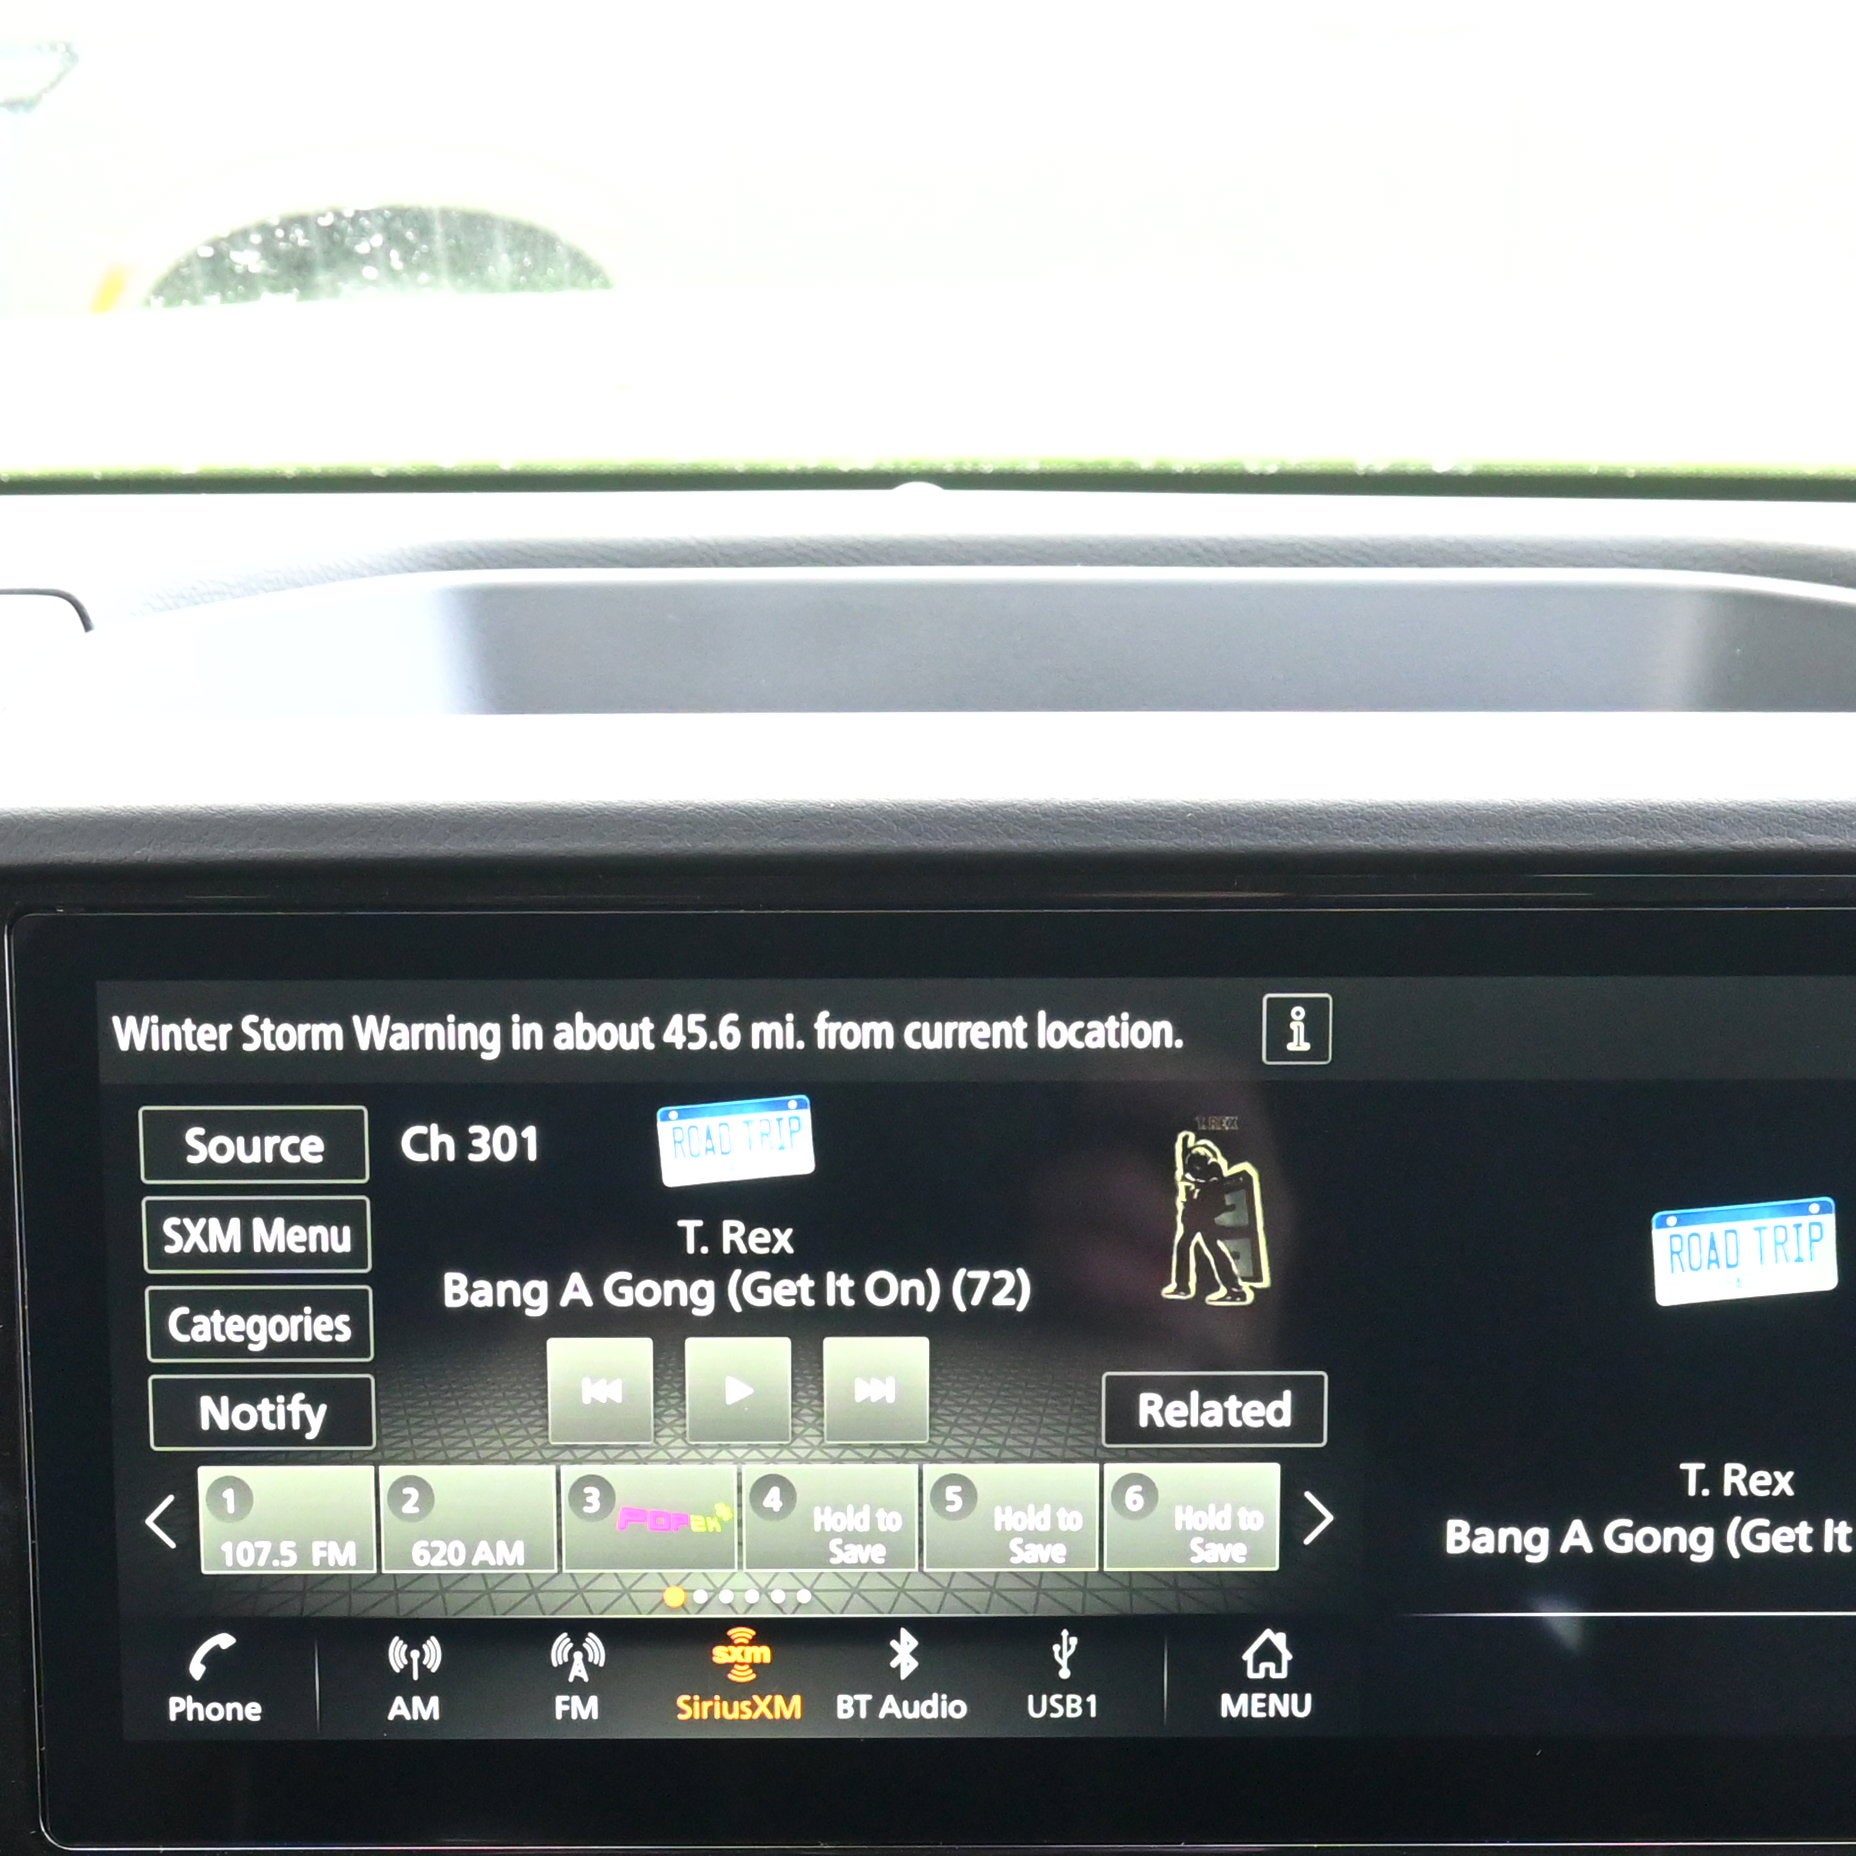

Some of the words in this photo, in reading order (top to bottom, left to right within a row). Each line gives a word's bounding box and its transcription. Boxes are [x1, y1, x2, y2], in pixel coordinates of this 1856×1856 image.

[111, 1013, 232, 1052] Winter
[242, 1013, 344, 1052] Storm
[353, 1013, 502, 1060] Warning
[512, 1013, 544, 1051] in
[553, 1012, 656, 1051] about
[662, 1013, 741, 1051] 45.6
[751, 1013, 805, 1050] mi.
[814, 1011, 894, 1050] from
[903, 1016, 1028, 1050] current
[1037, 1010, 1184, 1050] location.
[184, 1126, 325, 1165] Source
[400, 1124, 456, 1163] Ch
[467, 1125, 539, 1163] 301
[670, 1120, 732, 1161] ROAD
[742, 1113, 805, 1154] TRIP
[162, 1217, 241, 1255] SXM
[252, 1217, 352, 1255] Menu
[677, 1219, 709, 1255] T.
[723, 1219, 794, 1255] Rex
[1669, 1229, 1740, 1274] ROAD
[1753, 1221, 1825, 1265] TRIP
[443, 1272, 548, 1317] Bang
[560, 1273, 594, 1308] A
[603, 1271, 716, 1317] Gong
[726, 1270, 815, 1314] (Get
[824, 1271, 857, 1306] It
[865, 1269, 942, 1314] On)
[952, 1267, 1033, 1313] (72)
[168, 1306, 352, 1352] Categories
[198, 1394, 328, 1440] Notify
[1137, 1391, 1293, 1430] Related
[1678, 1462, 1711, 1496] T.
[1723, 1462, 1795, 1496] Rex
[221, 1488, 237, 1513] 1
[402, 1488, 420, 1513] 2
[581, 1486, 602, 1513] 3
[762, 1486, 784, 1513] 4
[943, 1486, 963, 1512] 5
[1124, 1485, 1144, 1512] 6
[813, 1504, 871, 1532] Hold
[875, 1507, 903, 1532] to
[994, 1504, 1049, 1532] Hold
[1056, 1506, 1084, 1532] to
[1174, 1503, 1230, 1531] Hold
[1236, 1505, 1265, 1531] to
[411, 1539, 467, 1568] 620
[473, 1540, 525, 1567] AM
[828, 1537, 887, 1565] Save
[1009, 1538, 1067, 1565] Save
[1189, 1537, 1248, 1565] Save
[1445, 1518, 1549, 1562] Bang
[1559, 1519, 1593, 1553] A
[1603, 1517, 1716, 1562] Gong
[1726, 1517, 1813, 1559] (Get
[1823, 1518, 1852, 1553] It
[220, 1540, 299, 1568] 107.5
[312, 1541, 357, 1567] FM
[711, 1642, 773, 1665] sxm
[168, 1696, 263, 1723] Phone
[387, 1697, 440, 1721] AM
[554, 1695, 599, 1720] FM
[676, 1693, 802, 1720] SiriusXM
[836, 1694, 873, 1719] BT
[879, 1692, 968, 1719] Audio
[1027, 1693, 1098, 1718] USB1
[1220, 1692, 1313, 1718] MENU
